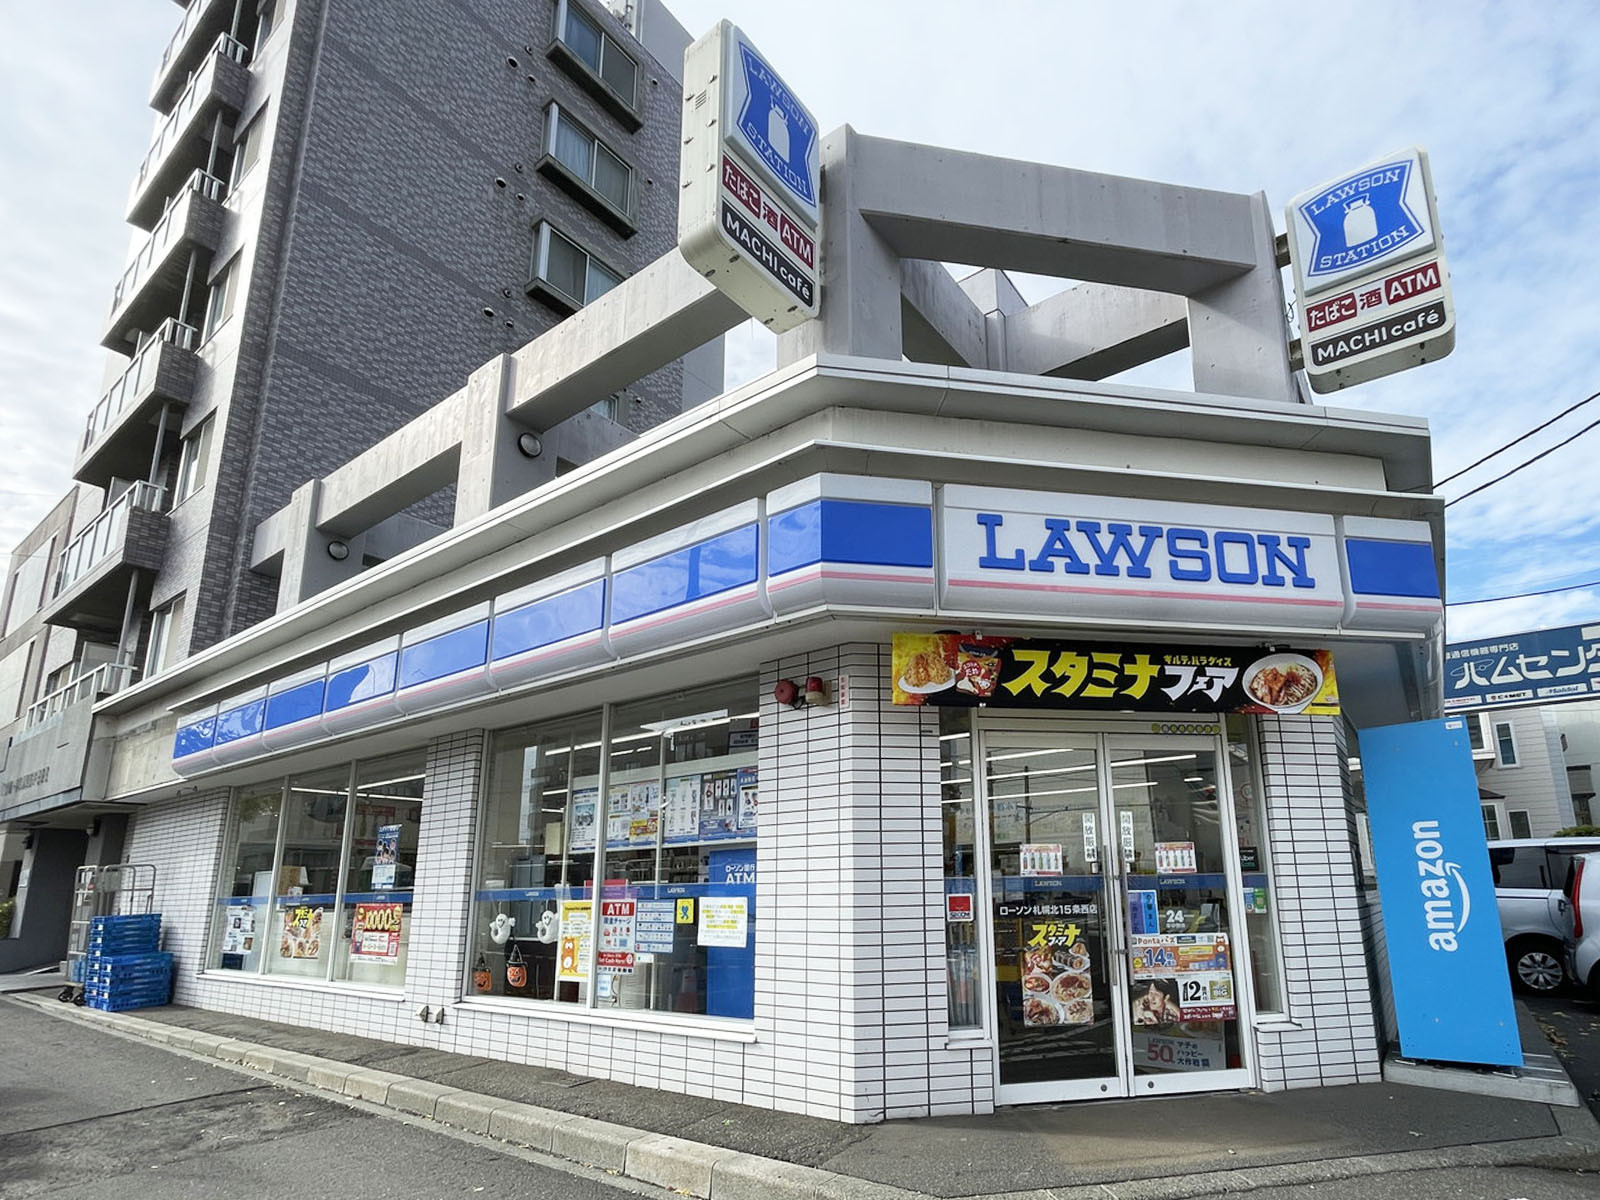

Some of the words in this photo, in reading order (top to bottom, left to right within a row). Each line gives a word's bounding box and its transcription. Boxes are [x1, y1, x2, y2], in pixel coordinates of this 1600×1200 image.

[747, 57, 811, 136] LAWSON
[746, 121, 808, 196] STATION
[724, 163, 760, 214] たばこ
[762, 201, 777, 230] 酒
[781, 225, 813, 264] ATM
[1310, 169, 1400, 216] LAWSON
[726, 211, 778, 272] MACHI
[779, 267, 811, 300] café
[1320, 225, 1409, 269] STATION
[1309, 294, 1357, 328] たばこ
[1360, 287, 1382, 311] 酒
[1389, 267, 1438, 300] ATM
[1317, 329, 1387, 362] MACHI
[1391, 308, 1440, 337] café
[976, 512, 1317, 589] LAWSON
[726, 872, 756, 884] ATM
[1411, 818, 1460, 953] amazon
[606, 903, 630, 915] ATM
[1166, 909, 1185, 923] 24
[1028, 923, 1082, 947] スタミナ
[1145, 947, 1167, 968] 14
[1183, 980, 1201, 1001] 12
